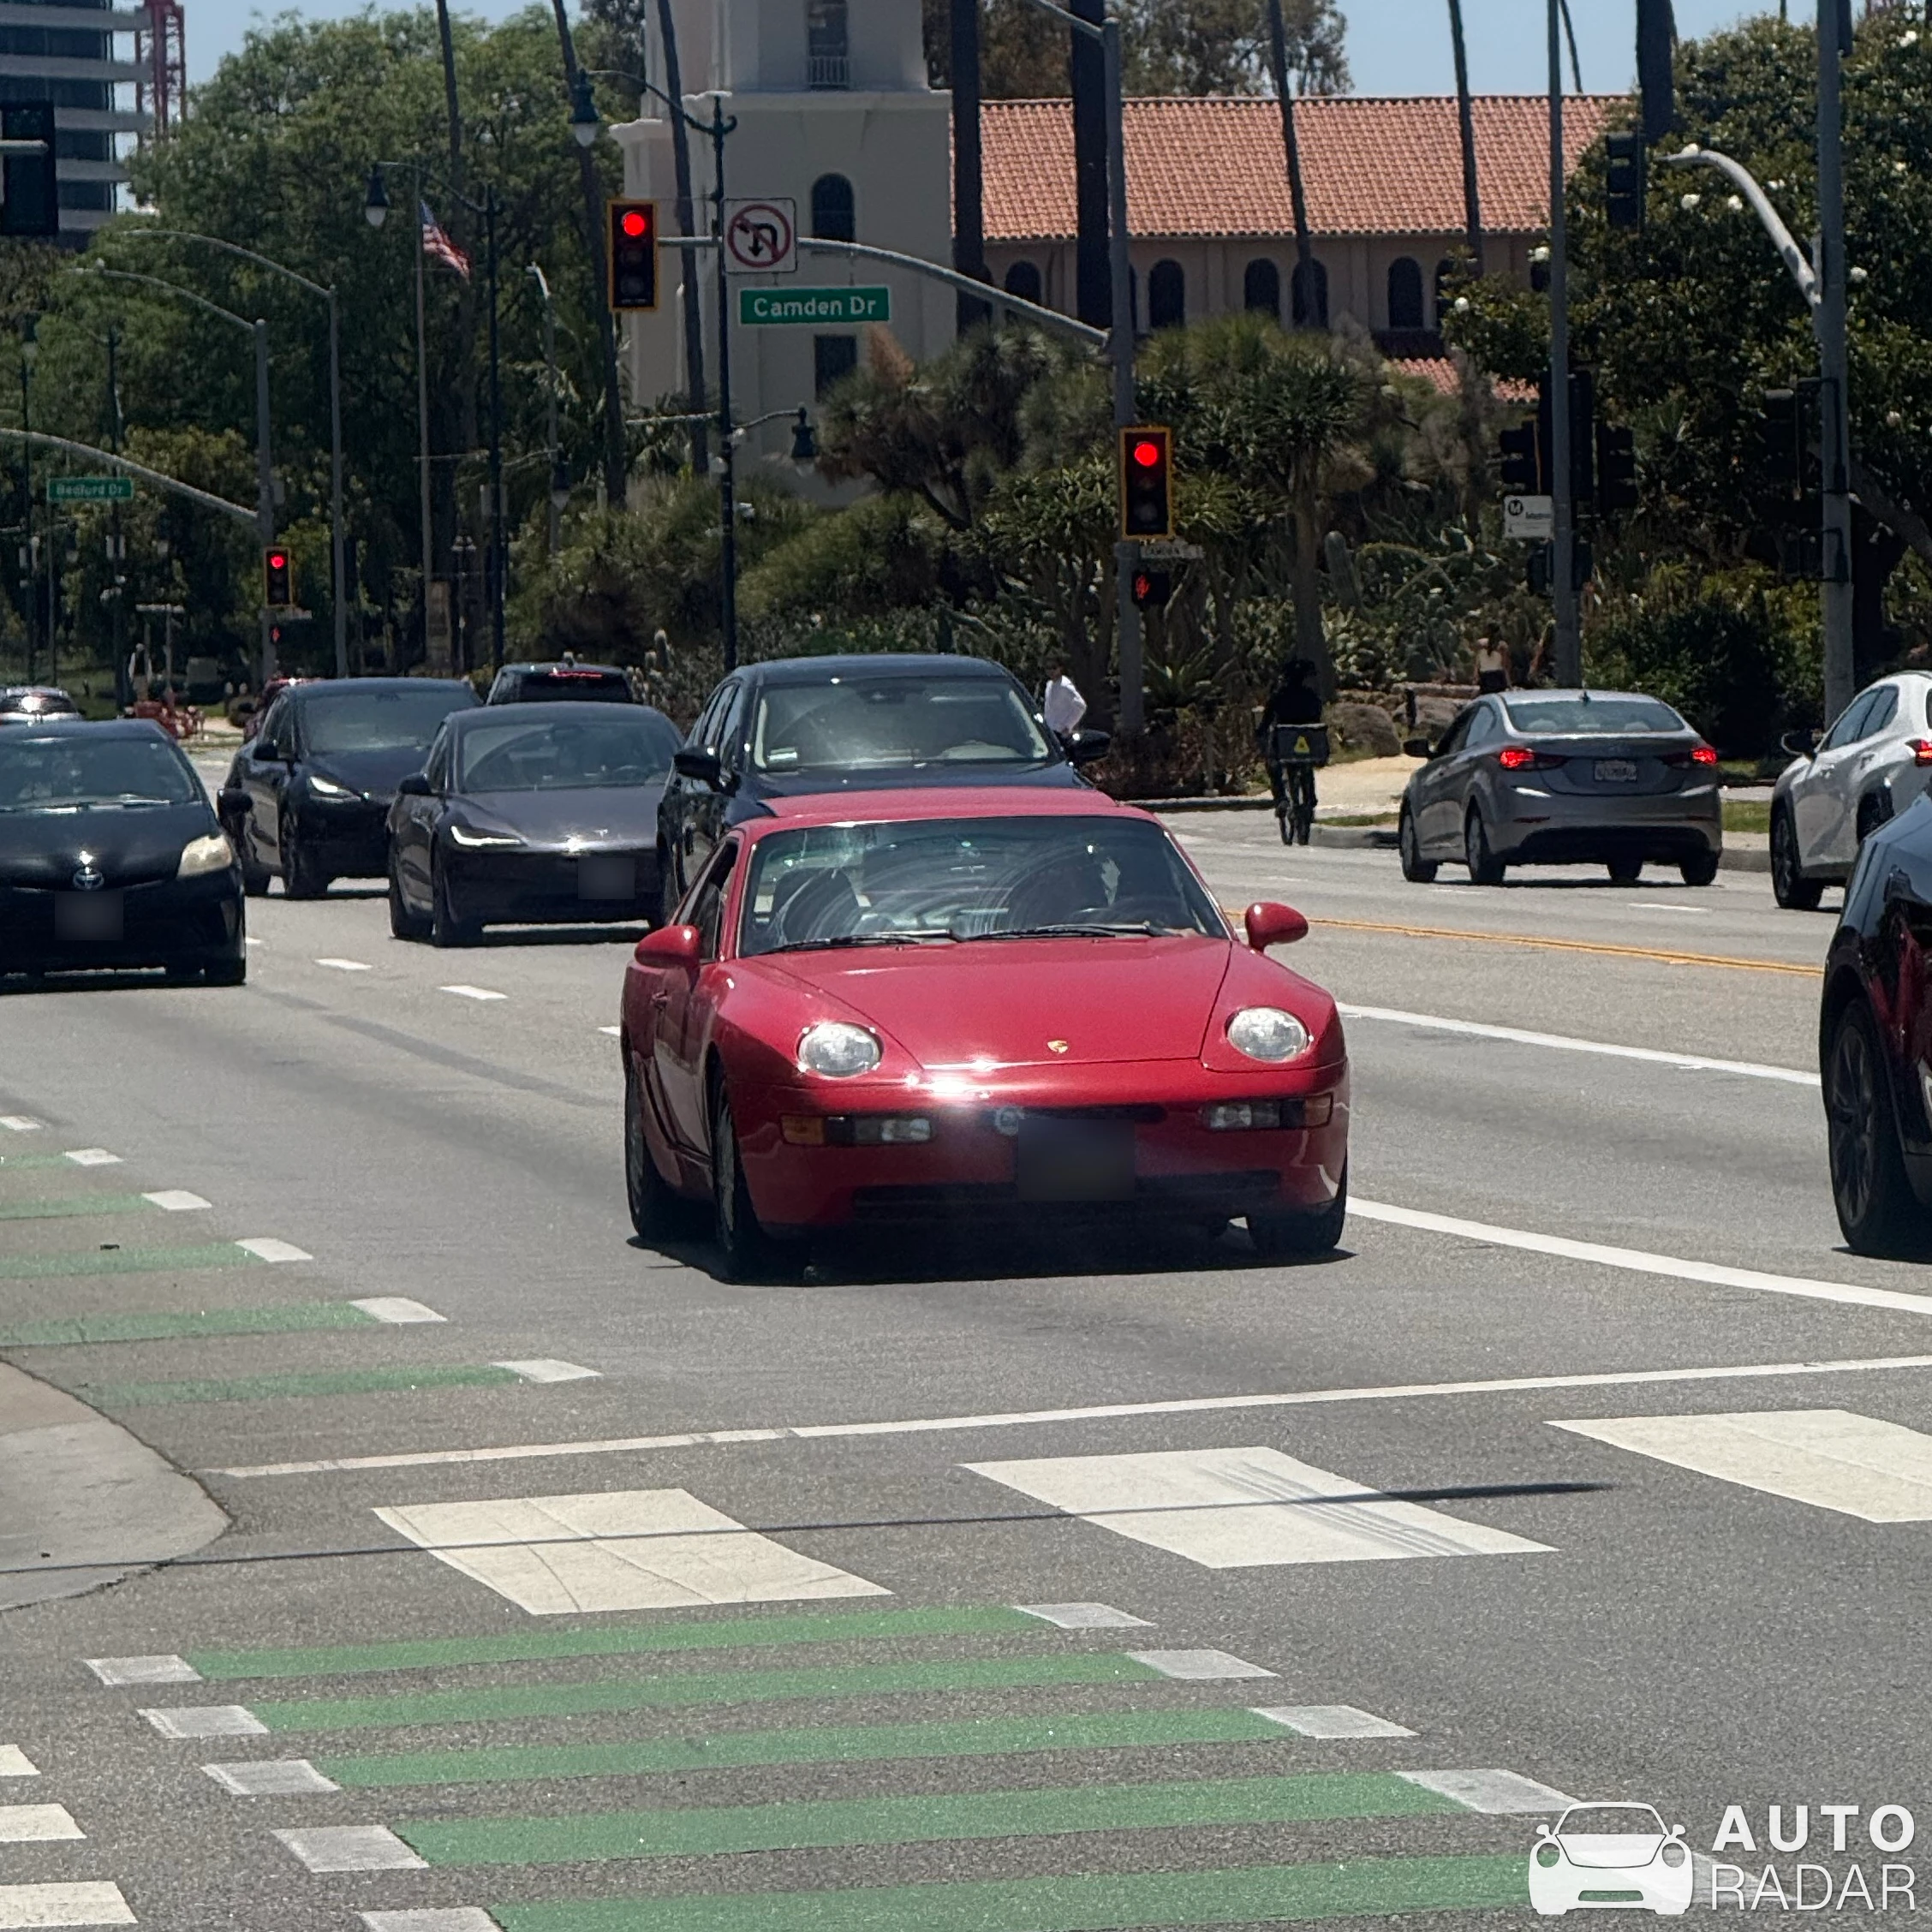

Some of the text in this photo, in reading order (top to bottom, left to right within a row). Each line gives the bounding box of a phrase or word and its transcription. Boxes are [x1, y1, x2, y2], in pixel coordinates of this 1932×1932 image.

[754, 295, 877, 317] Camden Dr
[108, 483, 122, 496] Dr
